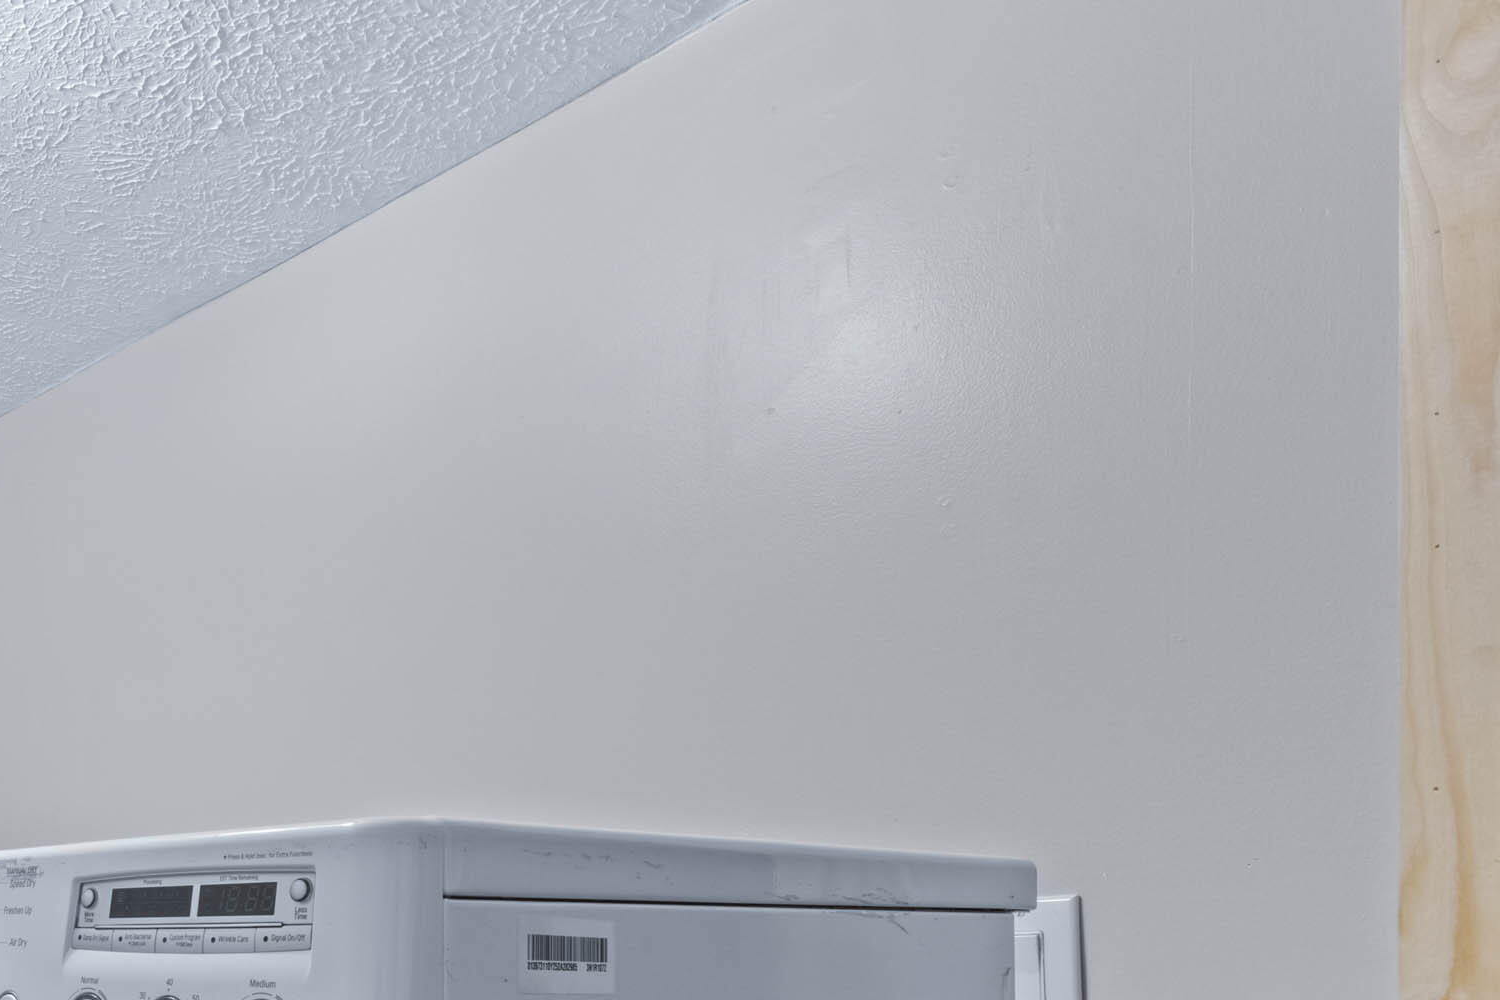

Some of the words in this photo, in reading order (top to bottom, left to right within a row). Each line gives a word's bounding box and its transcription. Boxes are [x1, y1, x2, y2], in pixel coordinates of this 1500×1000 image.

[26, 878, 37, 888] Dry
[18, 937, 28, 948] Dry
[270, 934, 287, 943] Signal
[166, 978, 174, 986] 40
[249, 979, 276, 989] Medium
